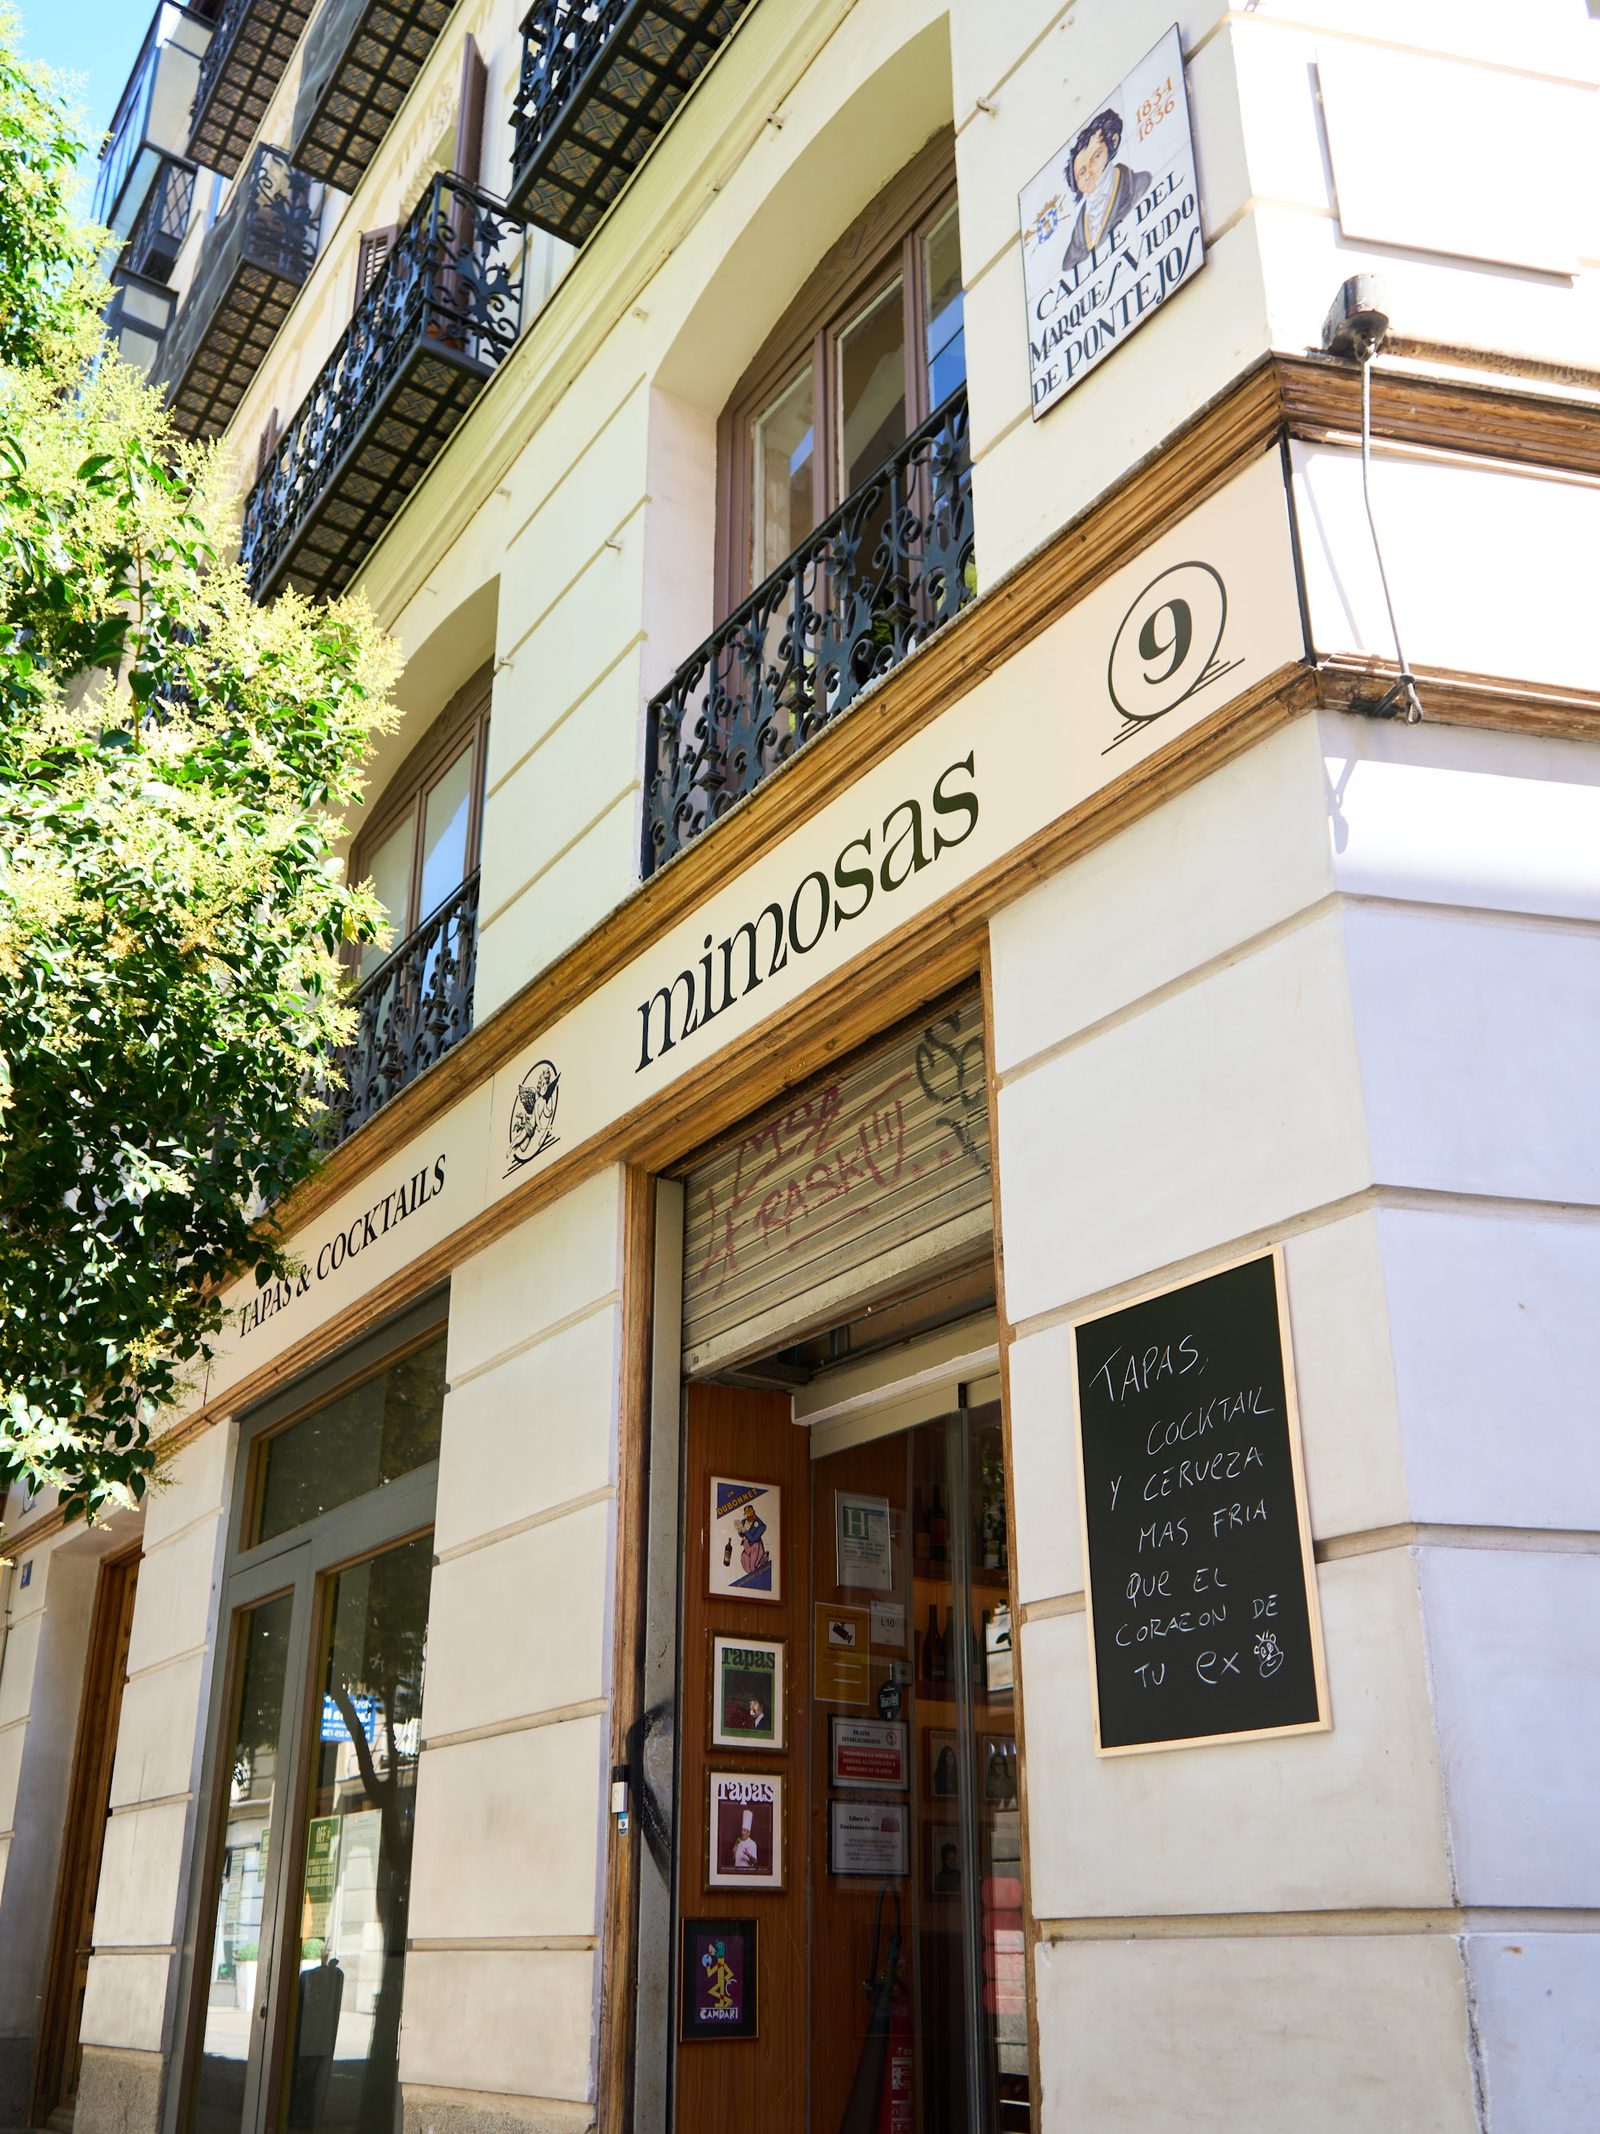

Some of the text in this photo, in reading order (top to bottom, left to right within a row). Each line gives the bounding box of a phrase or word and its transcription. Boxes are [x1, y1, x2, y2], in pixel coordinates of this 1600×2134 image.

[1135, 76, 1173, 126] 1834
[1137, 98, 1175, 143] 1836
[1036, 171, 1185, 321] CALLE DEL
[1030, 192, 1196, 373] MARQUES VIUDO
[1032, 225, 1200, 407] DE PONTEJOS
[1138, 597, 1193, 686] 9
[634, 748, 980, 1074] mimosas
[239, 1153, 447, 1339] TAPAS & COCKTAILS
[1146, 1386, 1277, 1456] COCKTAIL
[716, 1486, 758, 1515] DUBONNET
[1137, 1499, 1268, 1553] MAS FRIA
[1193, 1567, 1228, 1592] EL
[1252, 1593, 1279, 1620] DE
[1135, 1661, 1166, 1689] TU
[700, 2007, 738, 2019] CAMPARI
